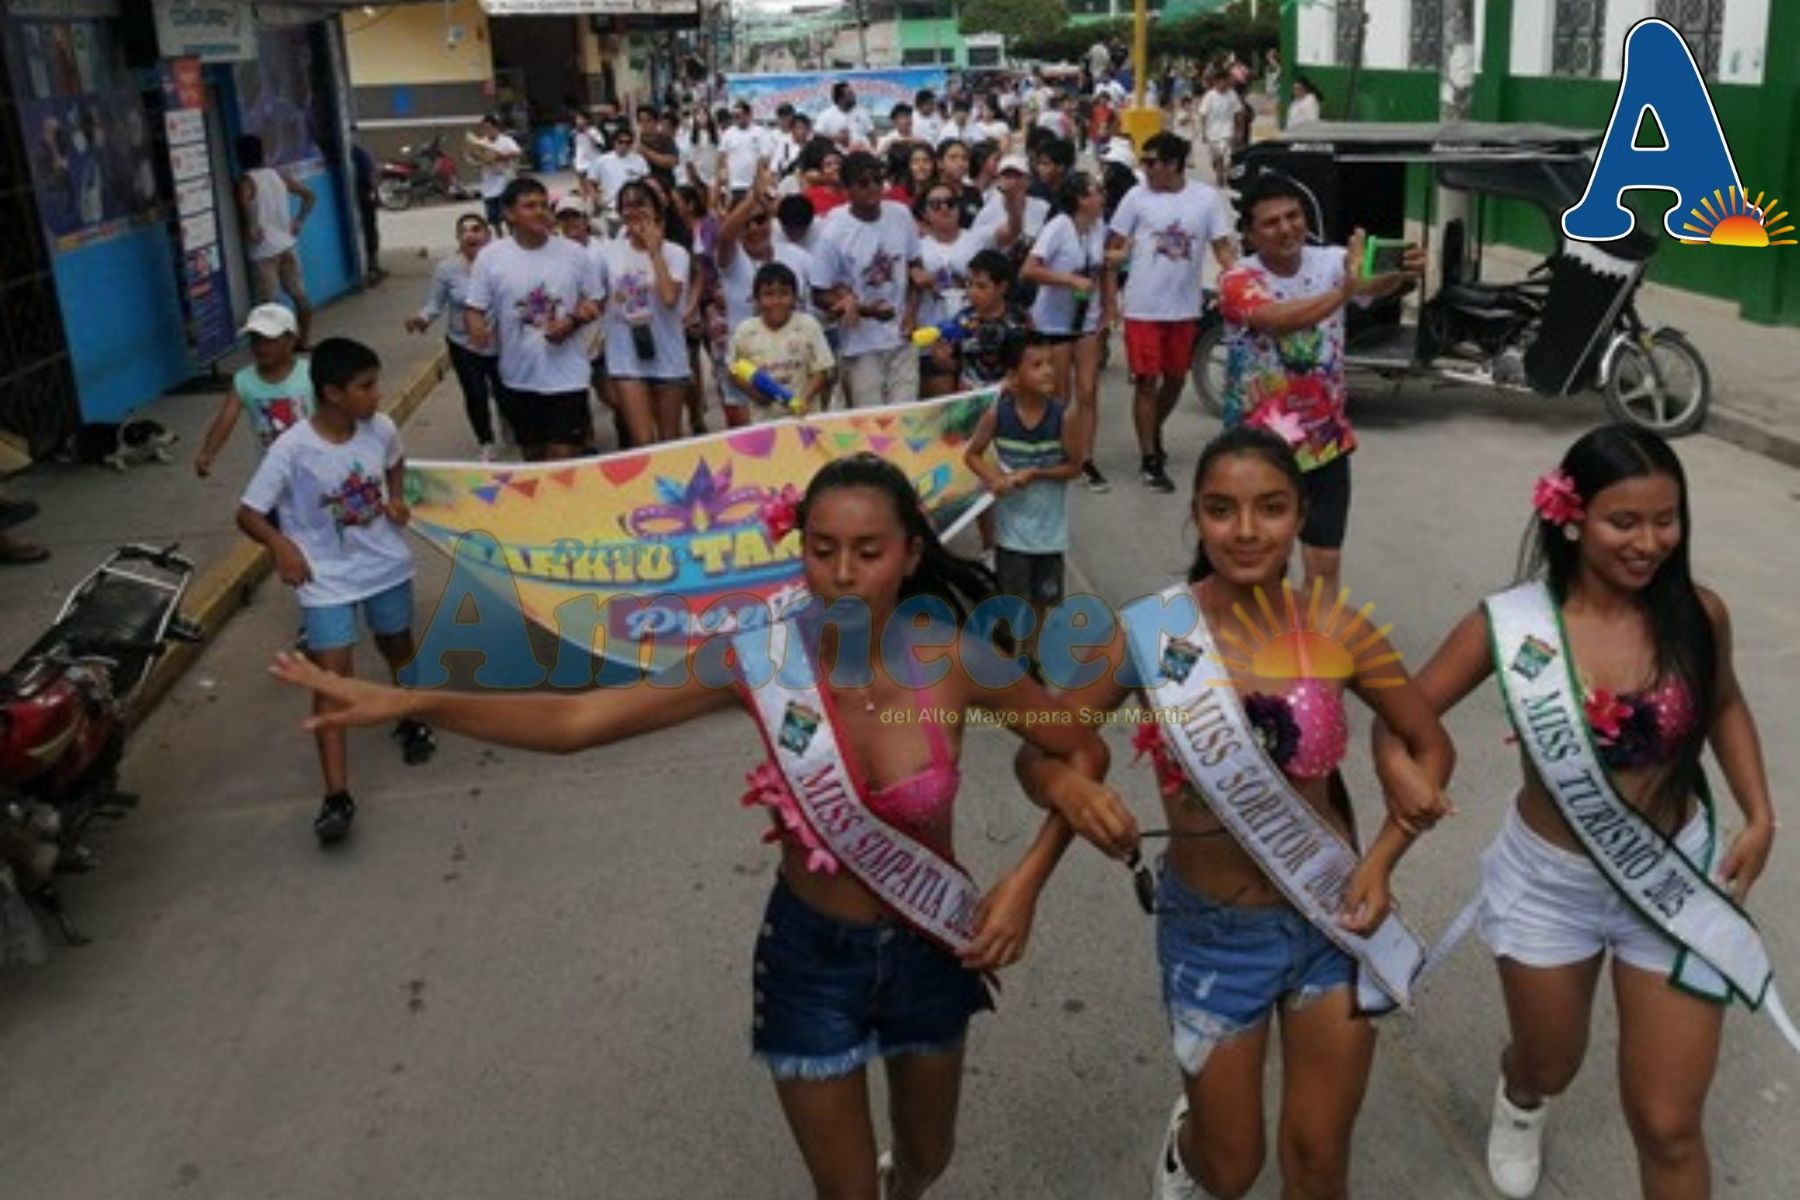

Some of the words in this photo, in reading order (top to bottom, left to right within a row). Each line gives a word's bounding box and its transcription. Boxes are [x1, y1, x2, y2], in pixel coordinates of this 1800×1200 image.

[797, 762, 865, 834] MISS
[1176, 688, 1242, 768] MISS
[1216, 764, 1321, 877] SORITOR
[1523, 690, 1582, 763] MISS
[1557, 769, 1660, 881] TURISMO
[1643, 868, 1695, 919] 2025
